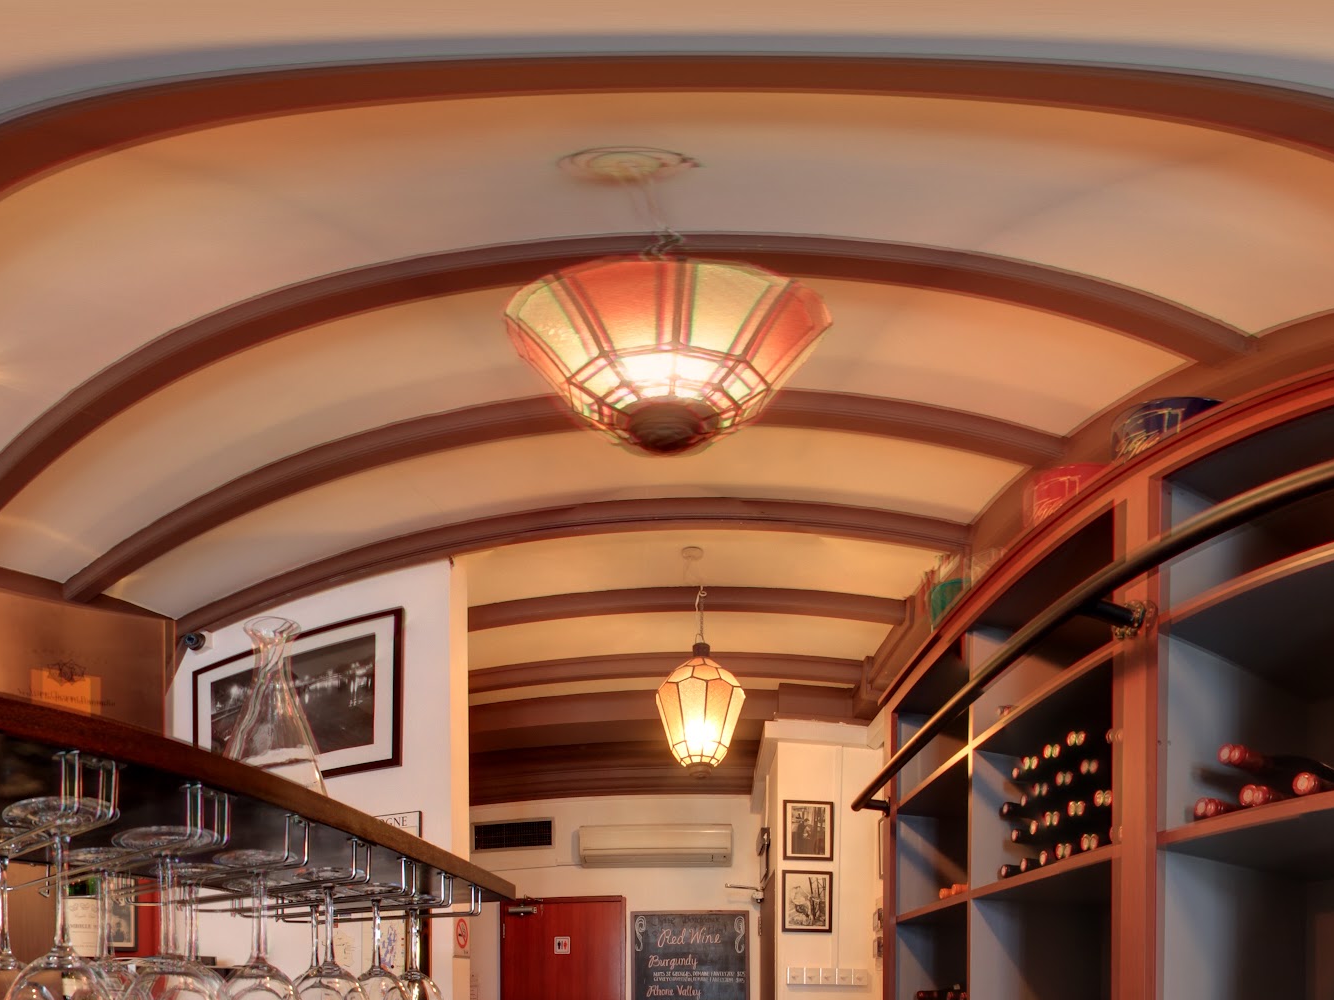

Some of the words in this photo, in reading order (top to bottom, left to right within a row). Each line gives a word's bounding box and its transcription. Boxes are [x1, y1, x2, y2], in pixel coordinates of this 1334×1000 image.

[658, 928, 686, 948] Red
[689, 927, 721, 944] Wine
[648, 954, 698, 970] Burgundy
[647, 985, 674, 997] Rhone
[676, 985, 702, 999] Valley
